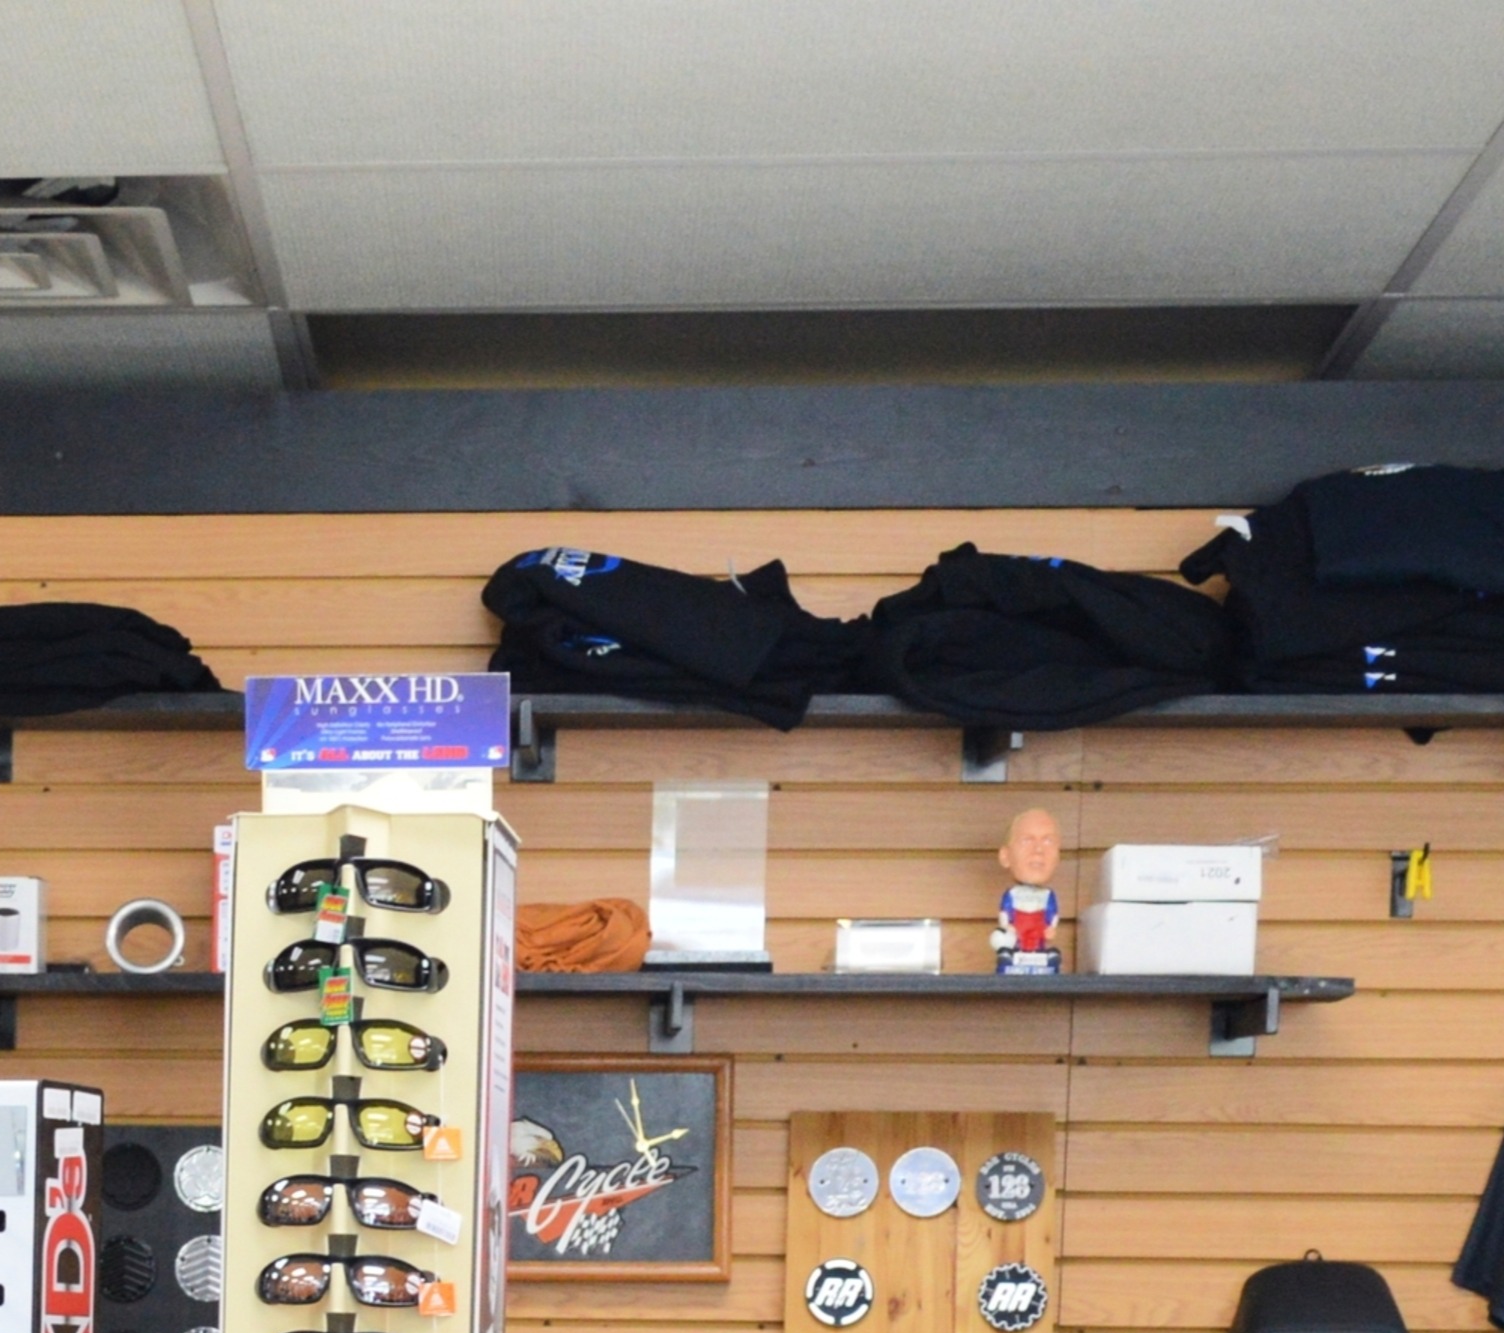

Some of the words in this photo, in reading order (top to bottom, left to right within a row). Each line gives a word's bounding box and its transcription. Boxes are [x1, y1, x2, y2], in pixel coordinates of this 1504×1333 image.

[295, 676, 401, 705] MAXX
[294, 704, 461, 717] sunglasses
[352, 749, 393, 761] ABOUT
[395, 749, 420, 760] THE
[526, 1147, 671, 1255] Cycle
